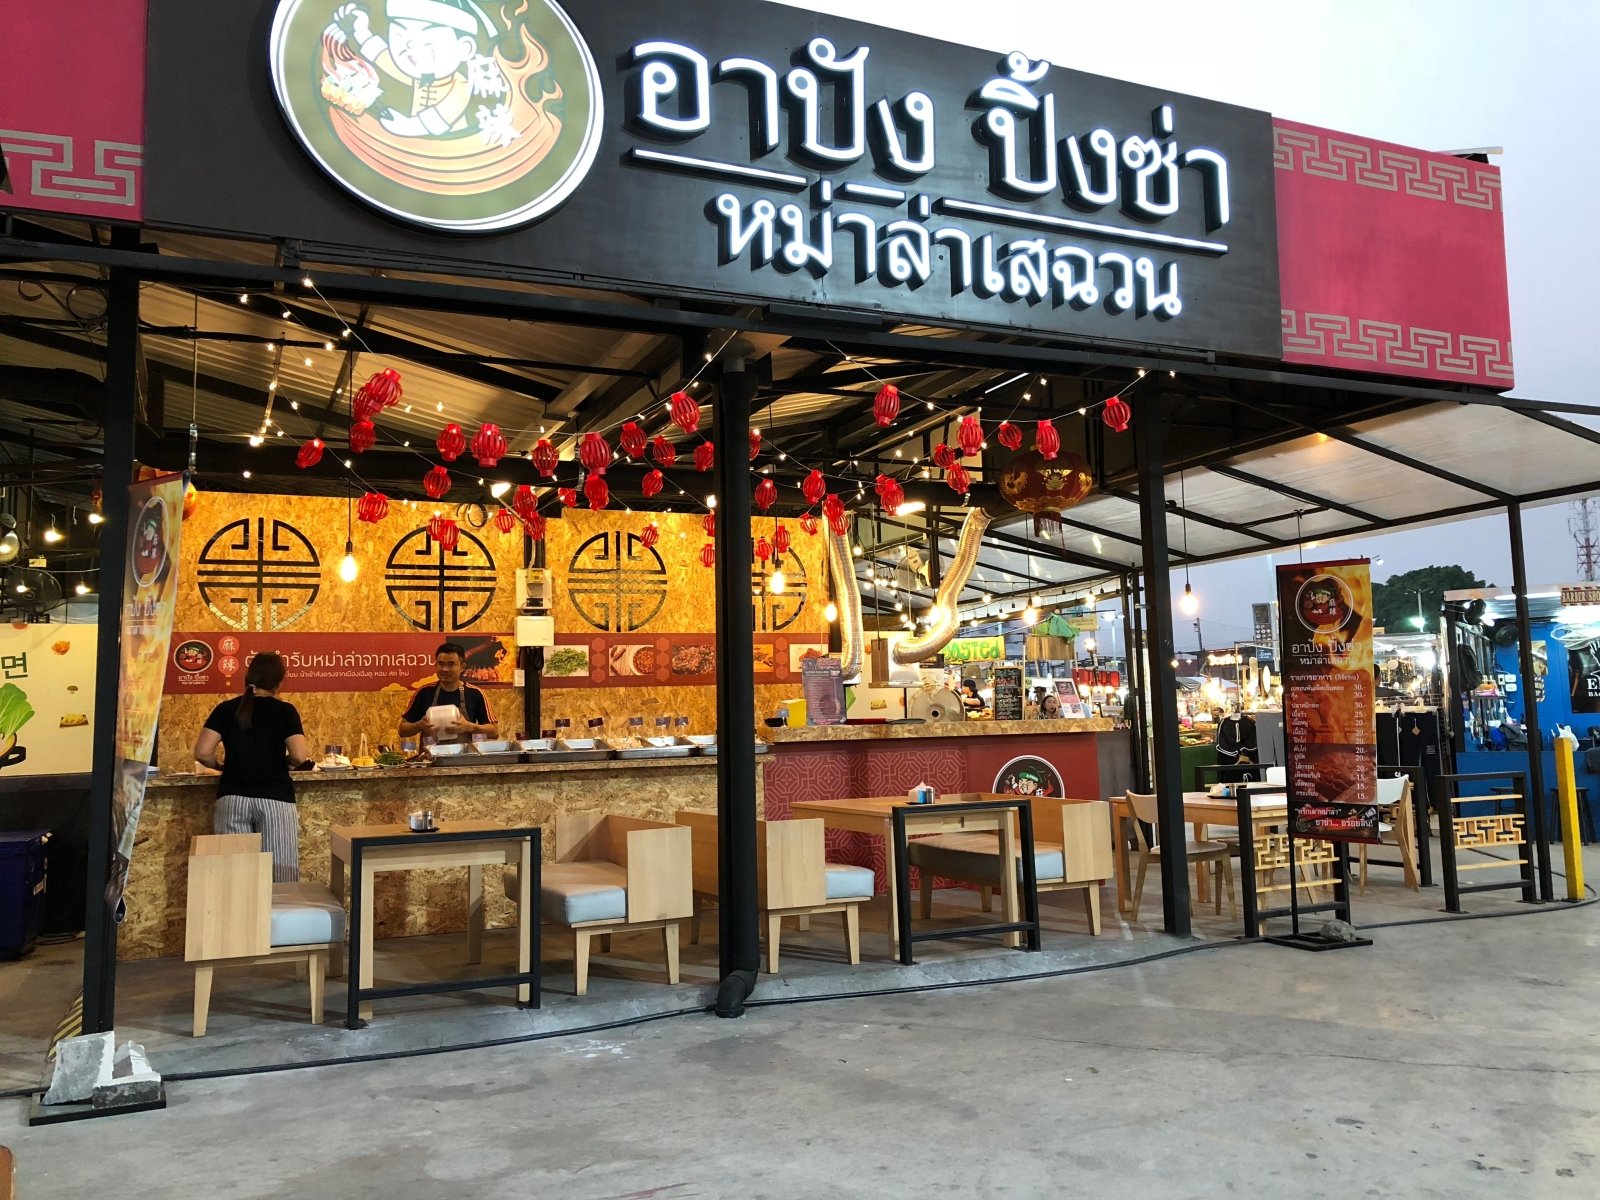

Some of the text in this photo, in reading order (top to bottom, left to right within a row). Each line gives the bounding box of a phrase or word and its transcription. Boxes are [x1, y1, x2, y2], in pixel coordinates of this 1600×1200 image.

[633, 36, 1231, 226] อาปัง ปิ้งซ่า
[716, 179, 1183, 318] หม่าล่าเสฉวน
[1561, 591, 1587, 603] BARBER
[1291, 637, 1323, 654] อาปัง
[0, 651, 29, 680] 면
[1586, 677, 1600, 691] E
